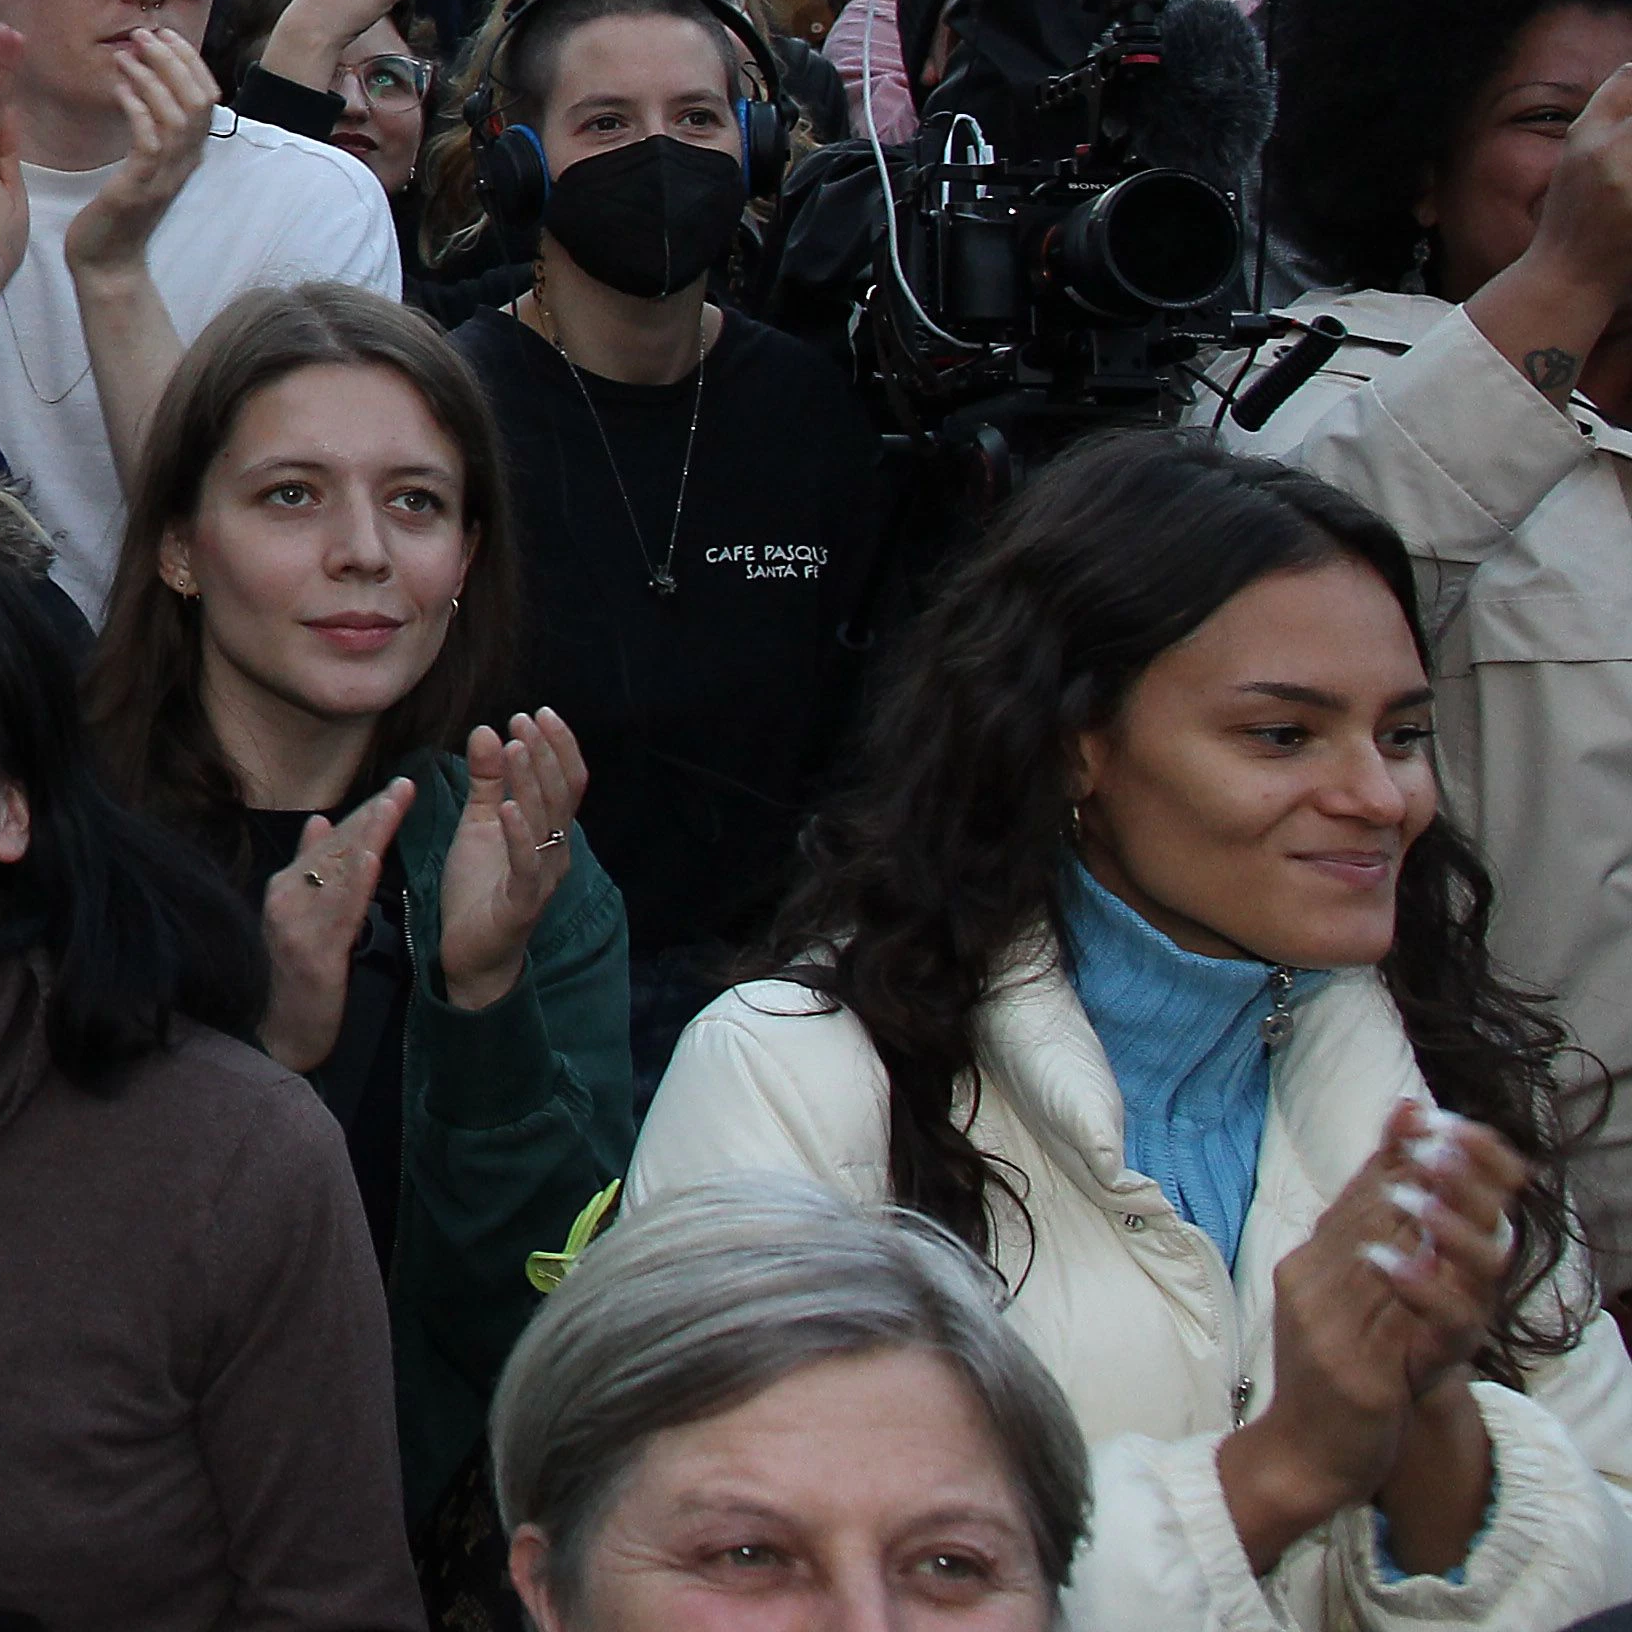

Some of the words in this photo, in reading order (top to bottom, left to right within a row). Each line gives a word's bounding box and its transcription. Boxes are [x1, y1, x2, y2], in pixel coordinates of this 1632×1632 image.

[1068, 182, 1110, 190] SONY
[705, 545, 756, 563] CAFE
[746, 563, 798, 579] SANTA
